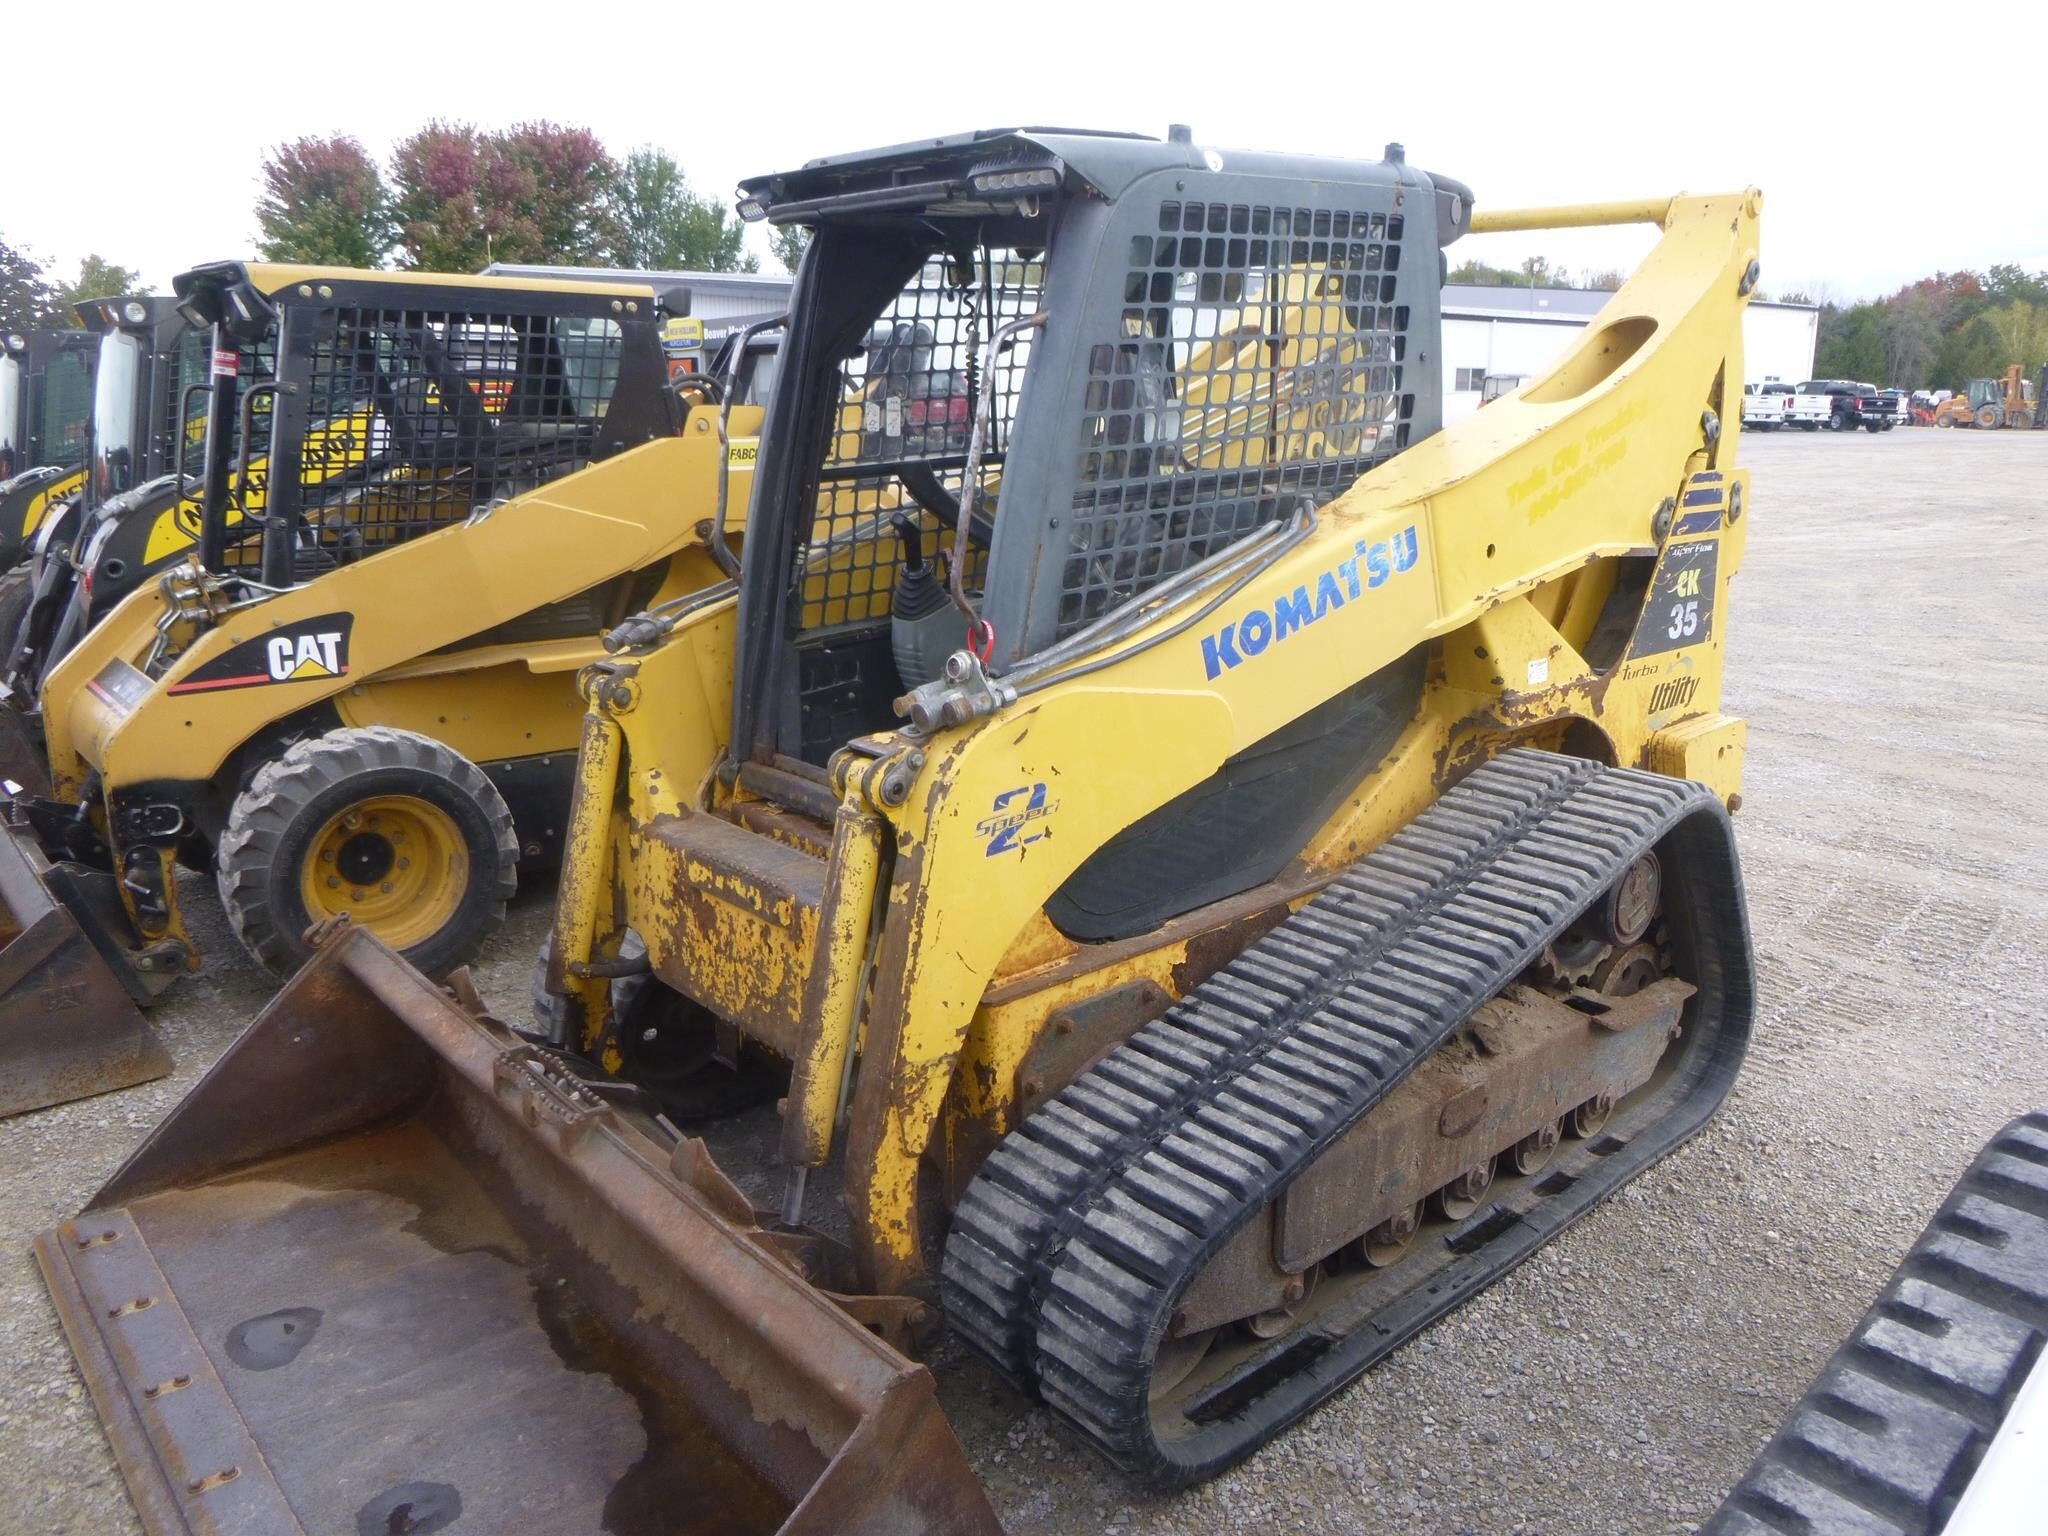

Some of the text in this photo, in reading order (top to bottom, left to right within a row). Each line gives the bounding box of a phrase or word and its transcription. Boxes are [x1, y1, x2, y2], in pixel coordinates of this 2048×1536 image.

[1200, 524, 1419, 682] KOMATSU
[1676, 568, 1702, 598] CK
[1667, 600, 1699, 640] 35
[267, 632, 343, 680] CAT
[1647, 675, 1701, 715] Utility
